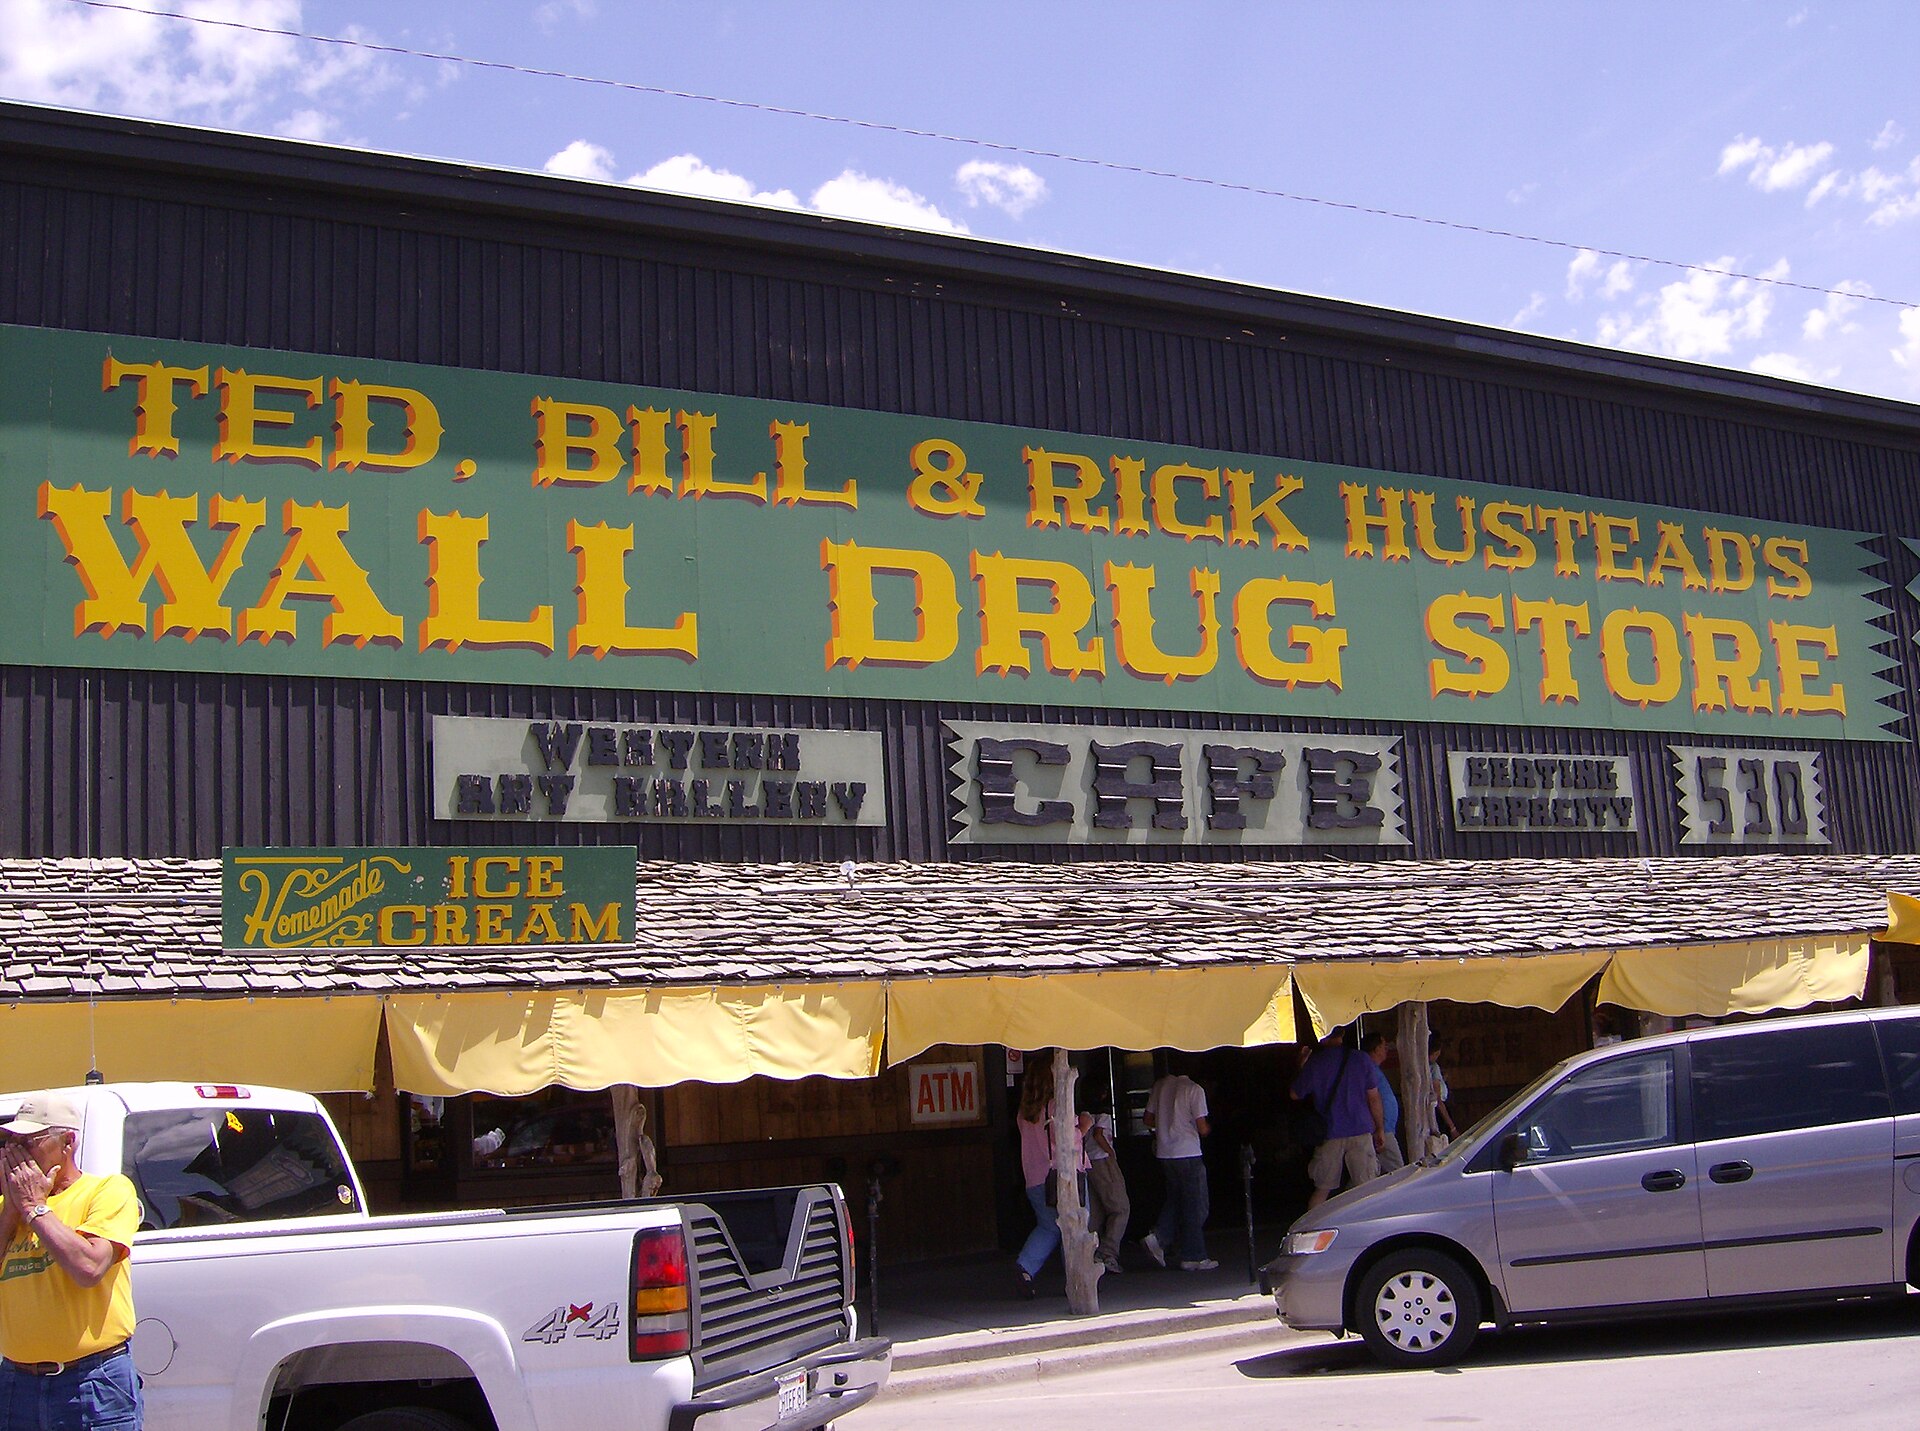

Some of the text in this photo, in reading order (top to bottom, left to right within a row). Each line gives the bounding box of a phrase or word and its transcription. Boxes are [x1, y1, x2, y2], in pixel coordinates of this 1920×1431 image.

[532, 395, 858, 511] BILL
[907, 438, 986, 519] &
[1022, 445, 1310, 553] RICK
[1339, 480, 1813, 599] HUSTEAD'S
[37, 480, 1847, 719] WALL DRUG STORE
[530, 721, 801, 772] WESTERN
[457, 773, 867, 820] ART GALLERY
[974, 737, 1386, 830] CAFE
[1466, 756, 1619, 791] SEATING
[1697, 755, 1809, 835] 530
[1457, 796, 1633, 828] CAPACITY
[448, 855, 565, 899] ICE
[239, 858, 386, 949] Homemade
[377, 902, 622, 946] CREAM
[916, 1072, 975, 1115] ATM
[9, 1262, 41, 1273] SINCE
